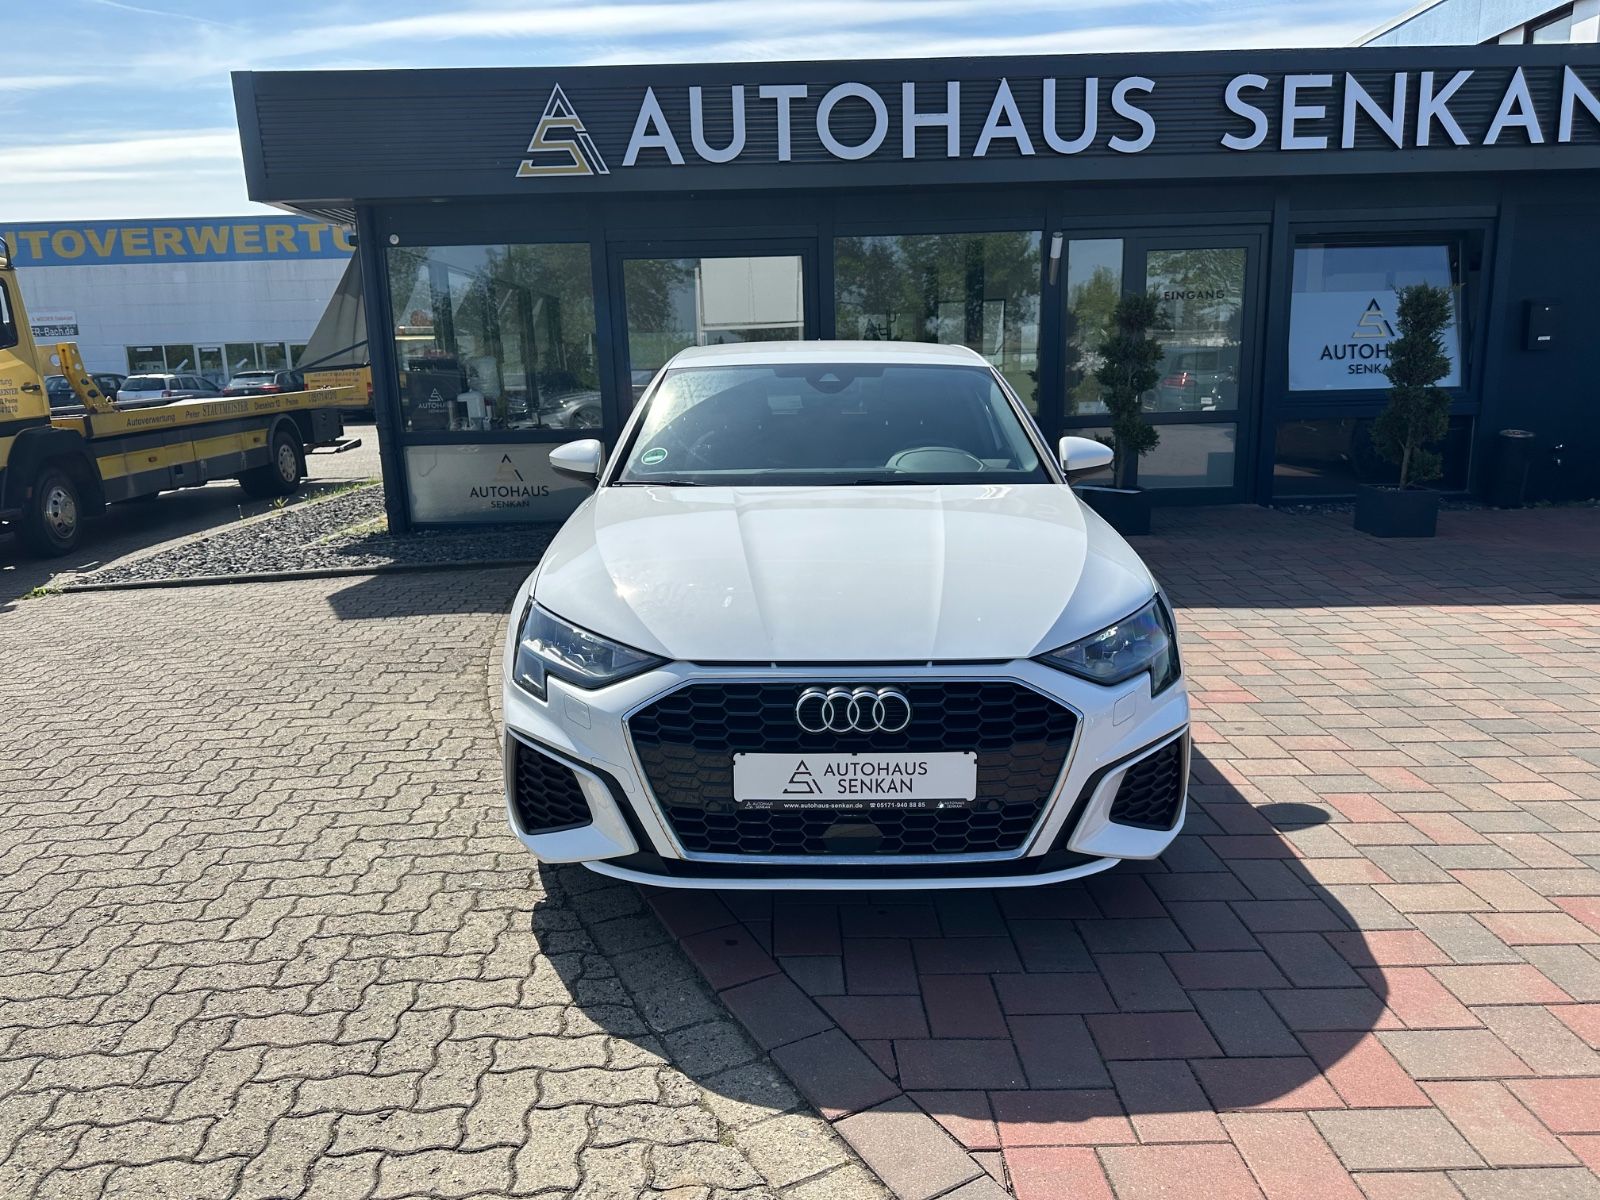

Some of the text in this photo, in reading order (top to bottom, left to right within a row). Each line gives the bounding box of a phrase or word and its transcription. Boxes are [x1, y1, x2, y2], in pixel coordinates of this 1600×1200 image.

[622, 64, 1600, 167] AUTOHAUS SENKAN
[1163, 289, 1225, 301] EINGANG
[1320, 343, 1389, 360] AUTOH
[1348, 363, 1389, 375] SENKA
[127, 414, 176, 427] Autoverwertung
[202, 400, 249, 417] STAUTMEISTER
[470, 485, 550, 498] AUTOHAUS
[490, 500, 530, 509] SENKAN
[824, 762, 928, 777] AUTOHAUS
[837, 778, 913, 794] SENKAN
